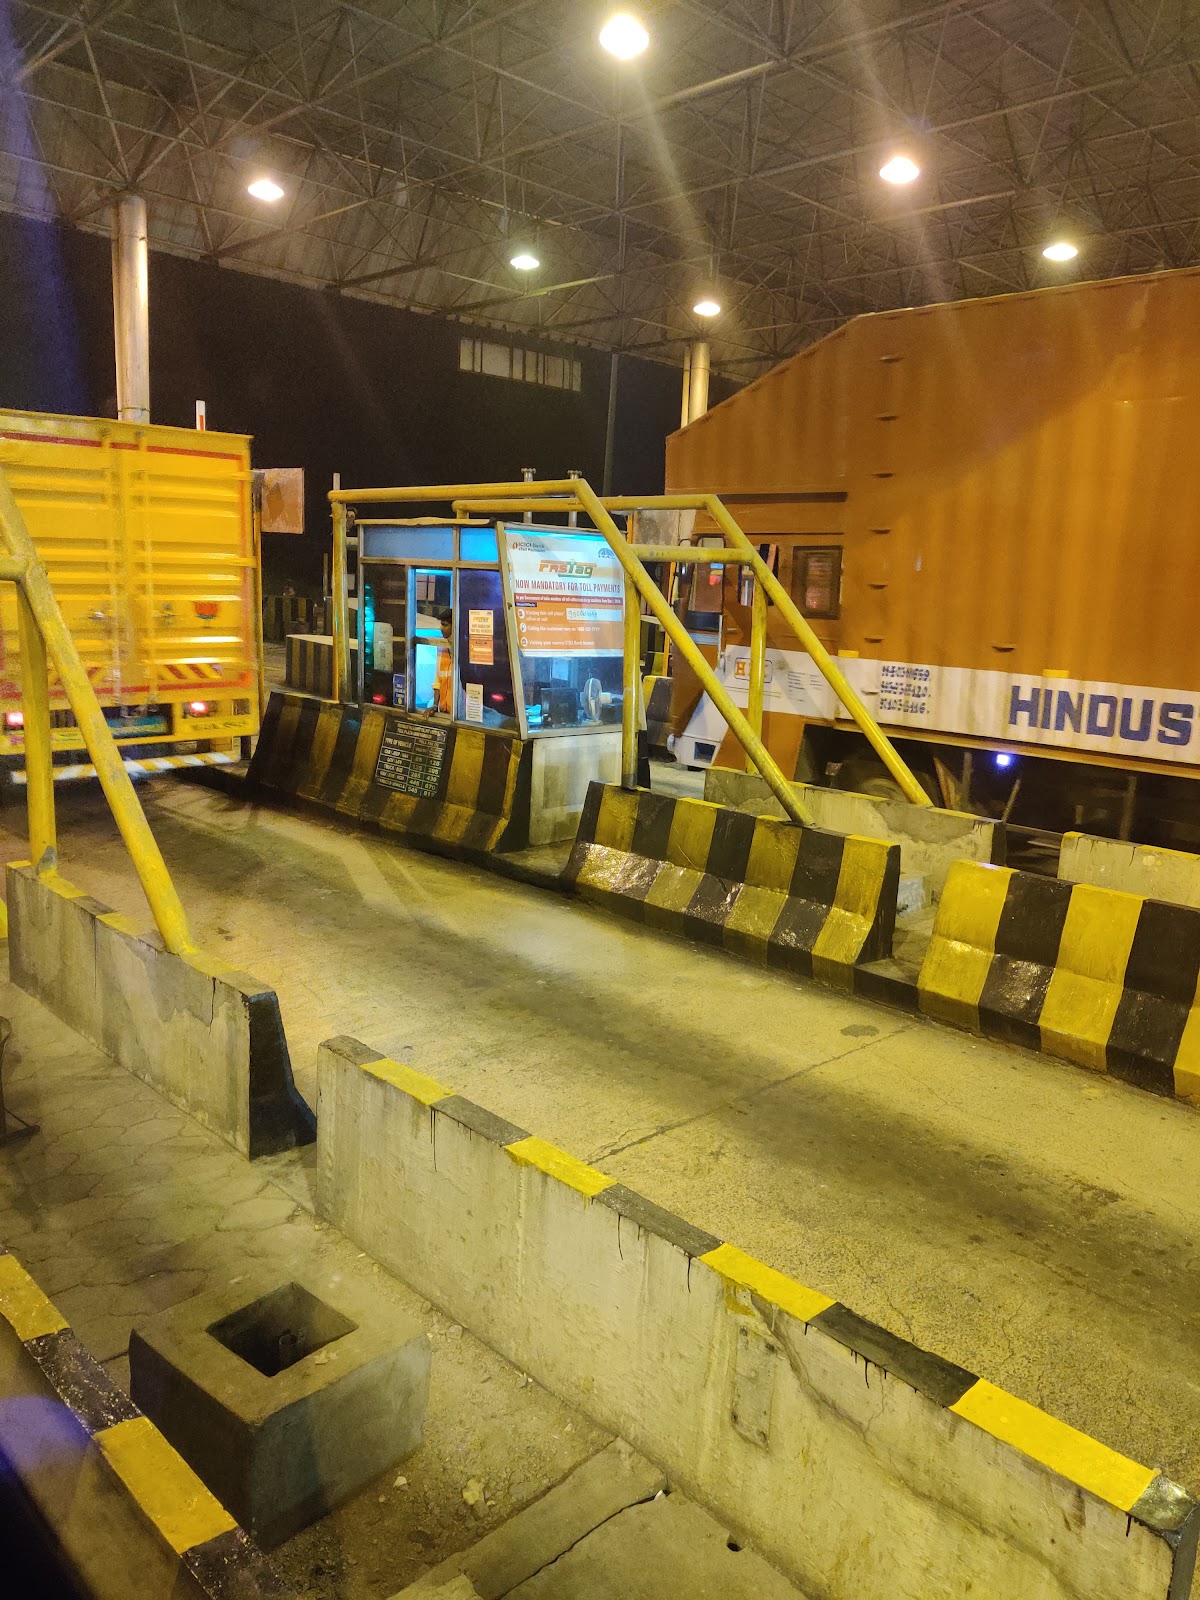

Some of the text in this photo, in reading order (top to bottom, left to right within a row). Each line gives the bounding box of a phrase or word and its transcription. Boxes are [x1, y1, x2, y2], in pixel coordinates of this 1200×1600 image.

[515, 579, 621, 594] NOW MANDATORY FOR TOLL PAYMENTS
[1008, 685, 1194, 746] HINDUS
